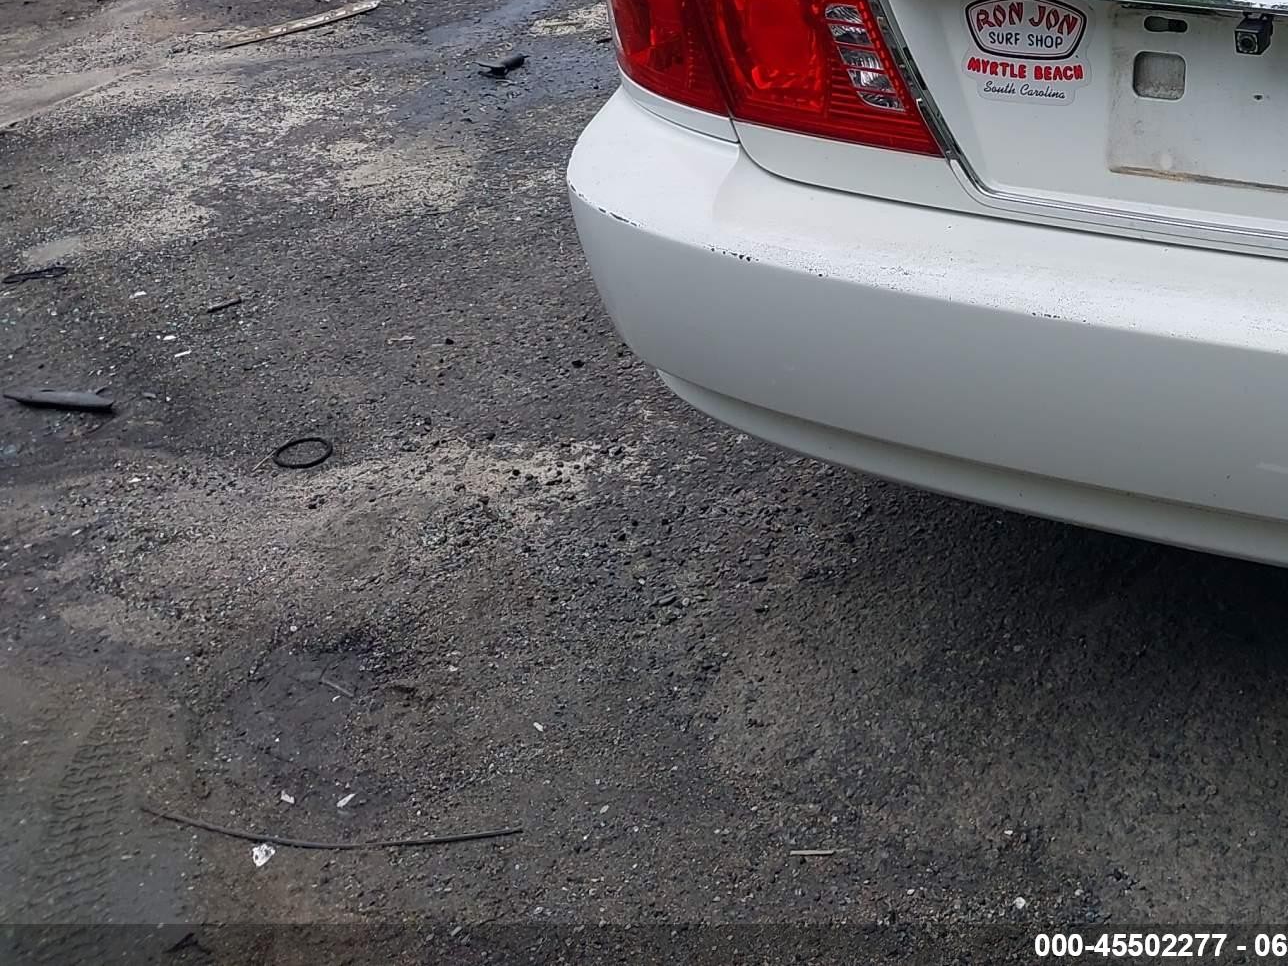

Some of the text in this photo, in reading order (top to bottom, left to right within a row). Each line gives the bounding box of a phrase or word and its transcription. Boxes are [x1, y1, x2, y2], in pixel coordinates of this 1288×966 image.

[976, 2, 1078, 36] RON JON
[988, 31, 1063, 49] SURF SHOP
[967, 56, 1084, 81] MYRTLE BEACH
[983, 80, 1065, 99] South Carolina
